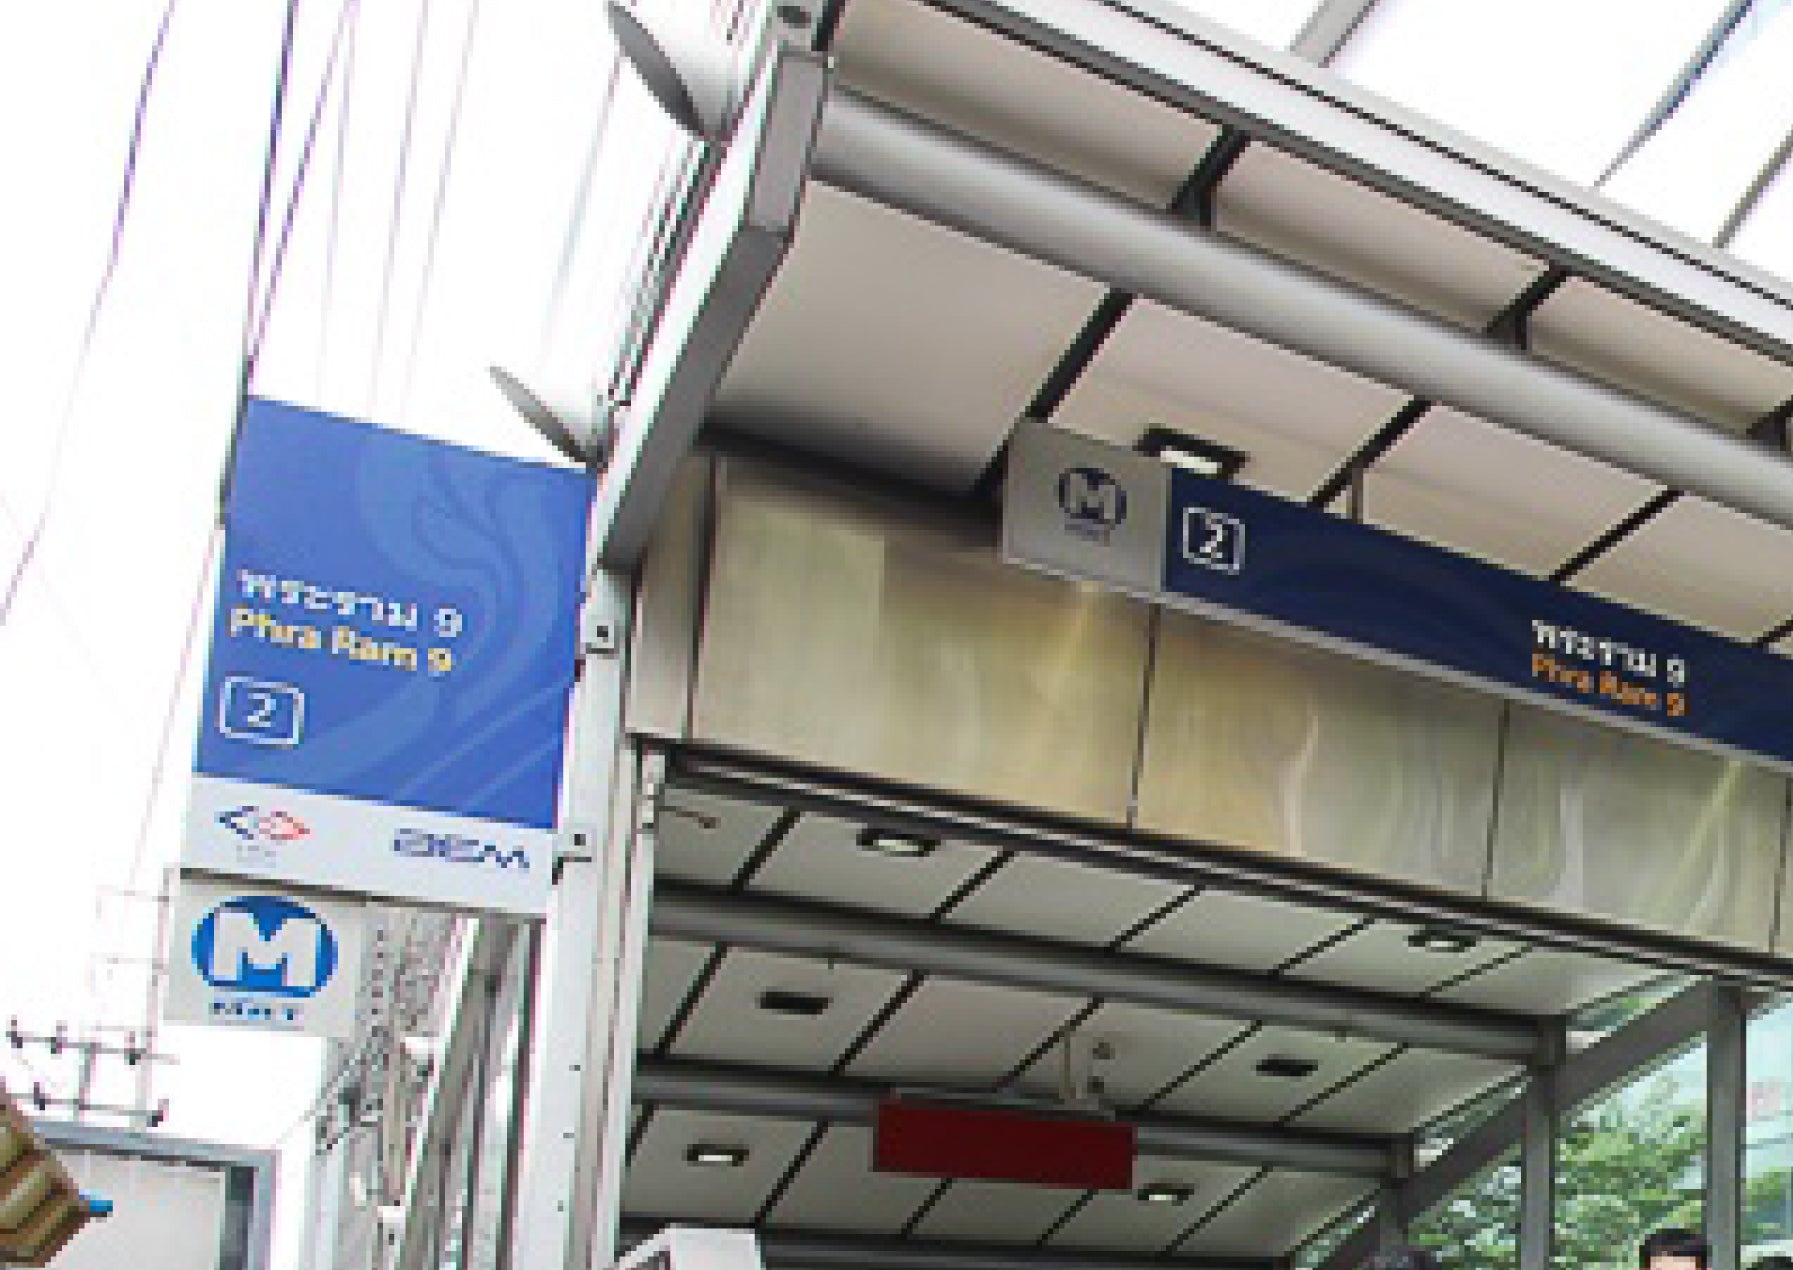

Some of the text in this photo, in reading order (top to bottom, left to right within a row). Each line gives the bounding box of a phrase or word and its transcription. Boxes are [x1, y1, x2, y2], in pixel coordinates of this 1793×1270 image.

[1199, 512, 1224, 561] 2
[227, 604, 322, 650] Phra
[331, 625, 418, 672] Ram
[1532, 652, 1592, 695] Phra
[1599, 670, 1658, 708] Ram
[247, 692, 277, 728] 2
